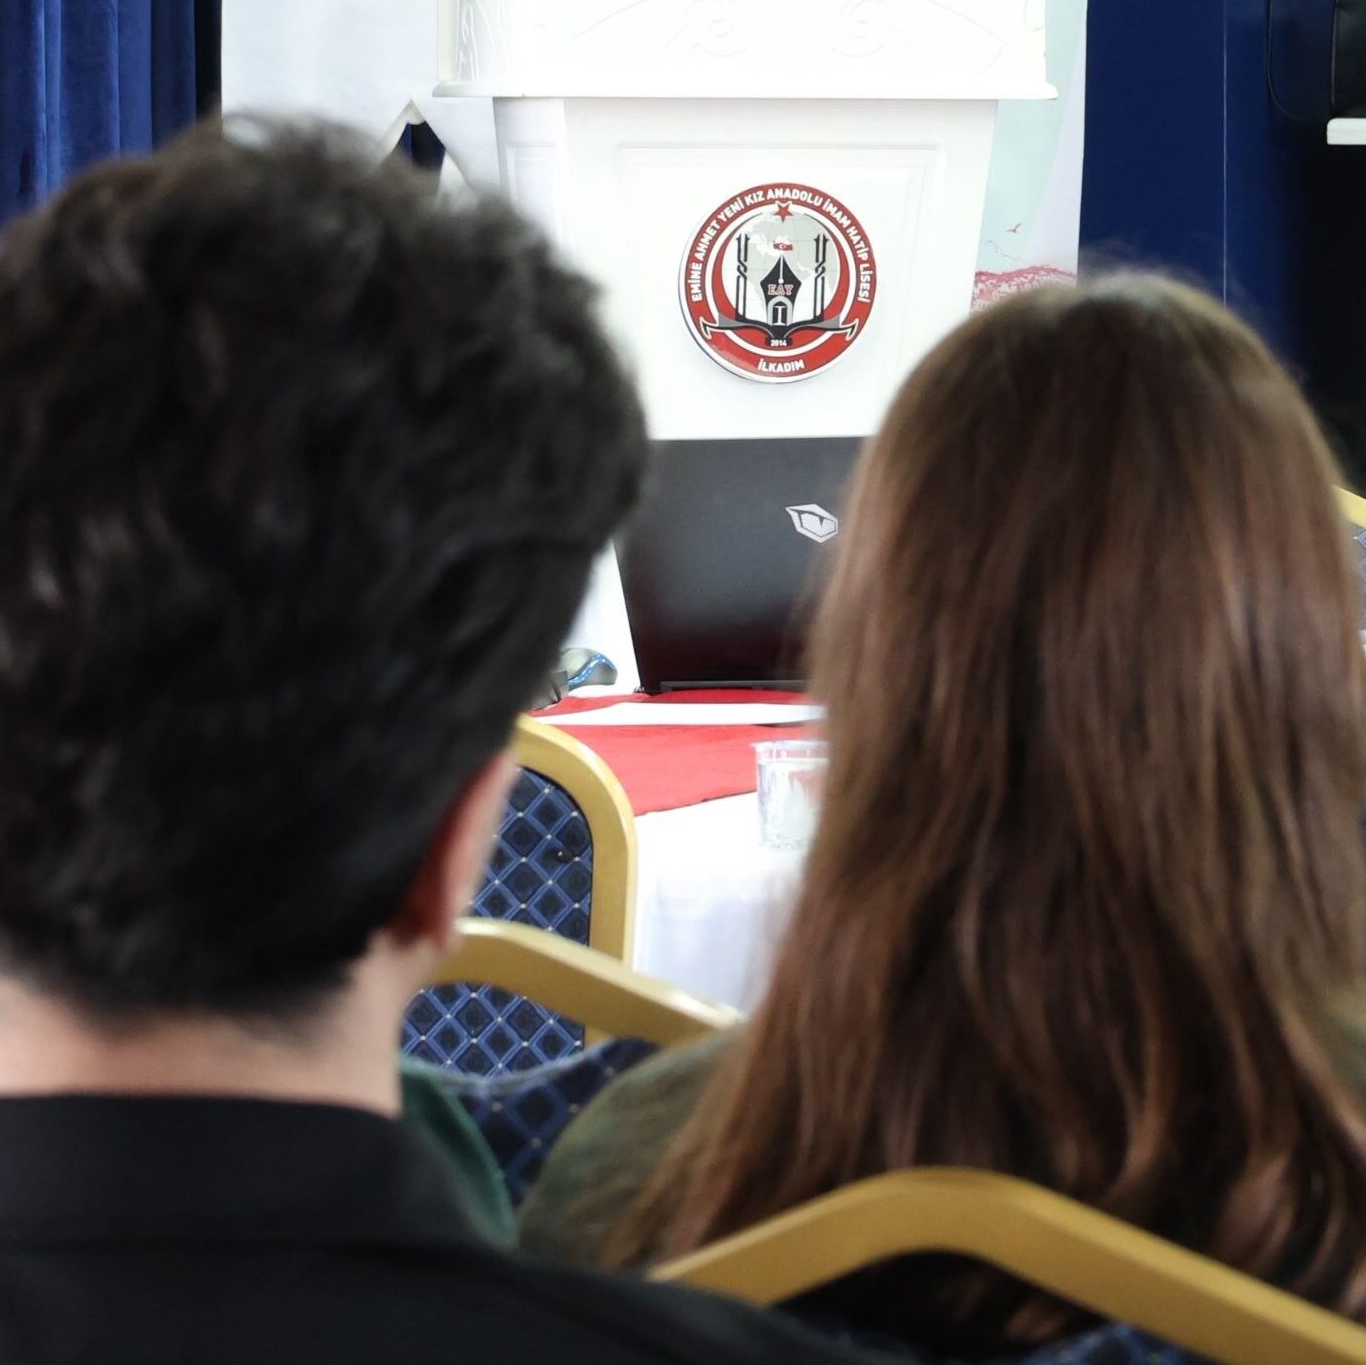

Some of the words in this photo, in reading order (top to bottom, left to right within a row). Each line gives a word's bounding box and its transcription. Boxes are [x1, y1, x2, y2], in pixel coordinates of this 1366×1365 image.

[717, 197, 745, 222] YENİ
[744, 190, 765, 207] KIZ
[766, 188, 824, 207] ANADOLU
[822, 198, 852, 229] İMAM
[694, 219, 721, 262] AHMET
[846, 225, 869, 262] HATİP
[687, 262, 703, 302] EMİNE
[767, 284, 794, 296] EAY
[757, 357, 805, 373] İLKADIM
